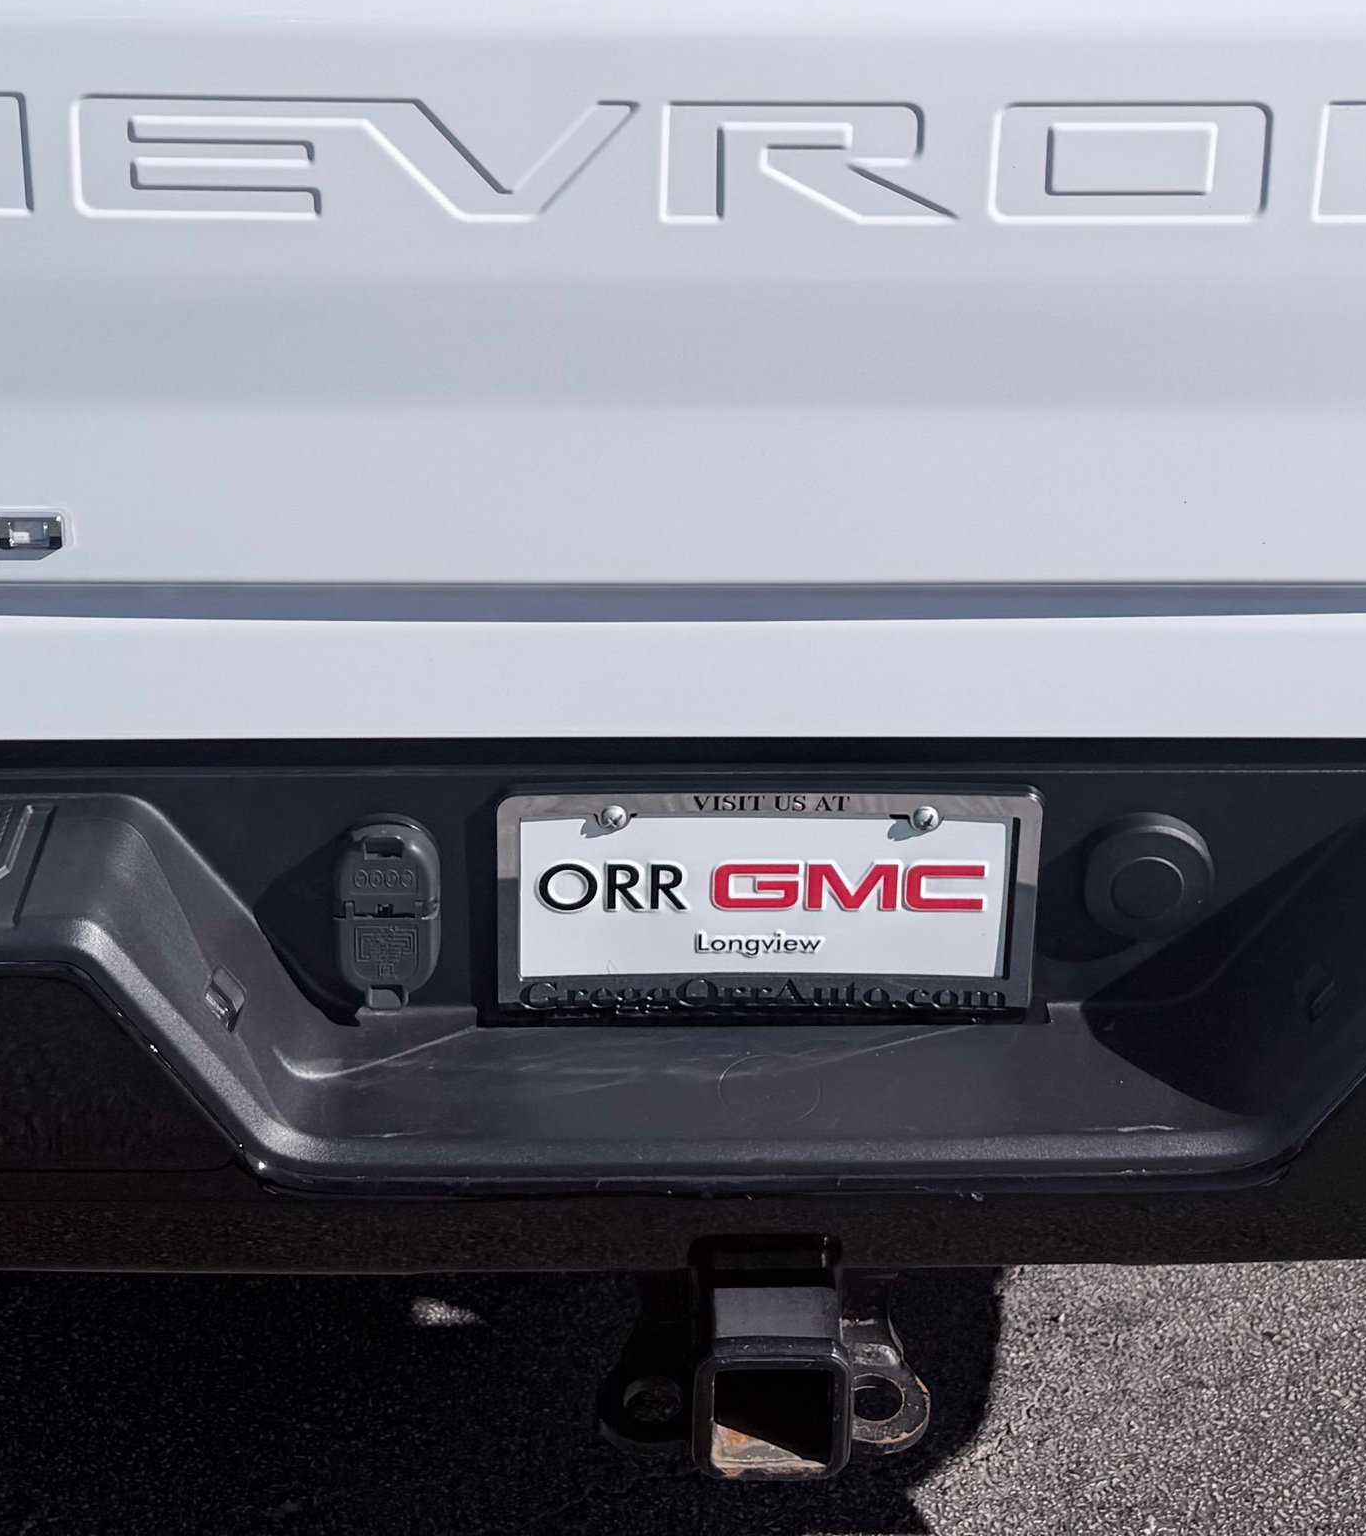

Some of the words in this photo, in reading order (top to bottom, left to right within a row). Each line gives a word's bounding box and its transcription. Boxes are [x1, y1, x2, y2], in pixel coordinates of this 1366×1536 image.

[693, 795, 767, 813] VISIT
[773, 795, 808, 813] US
[815, 795, 852, 813] AT
[537, 862, 688, 912] ORR
[710, 863, 987, 912] GMC
[695, 930, 824, 957] Longview
[518, 977, 1008, 1015] GreggOrrAuto.com
